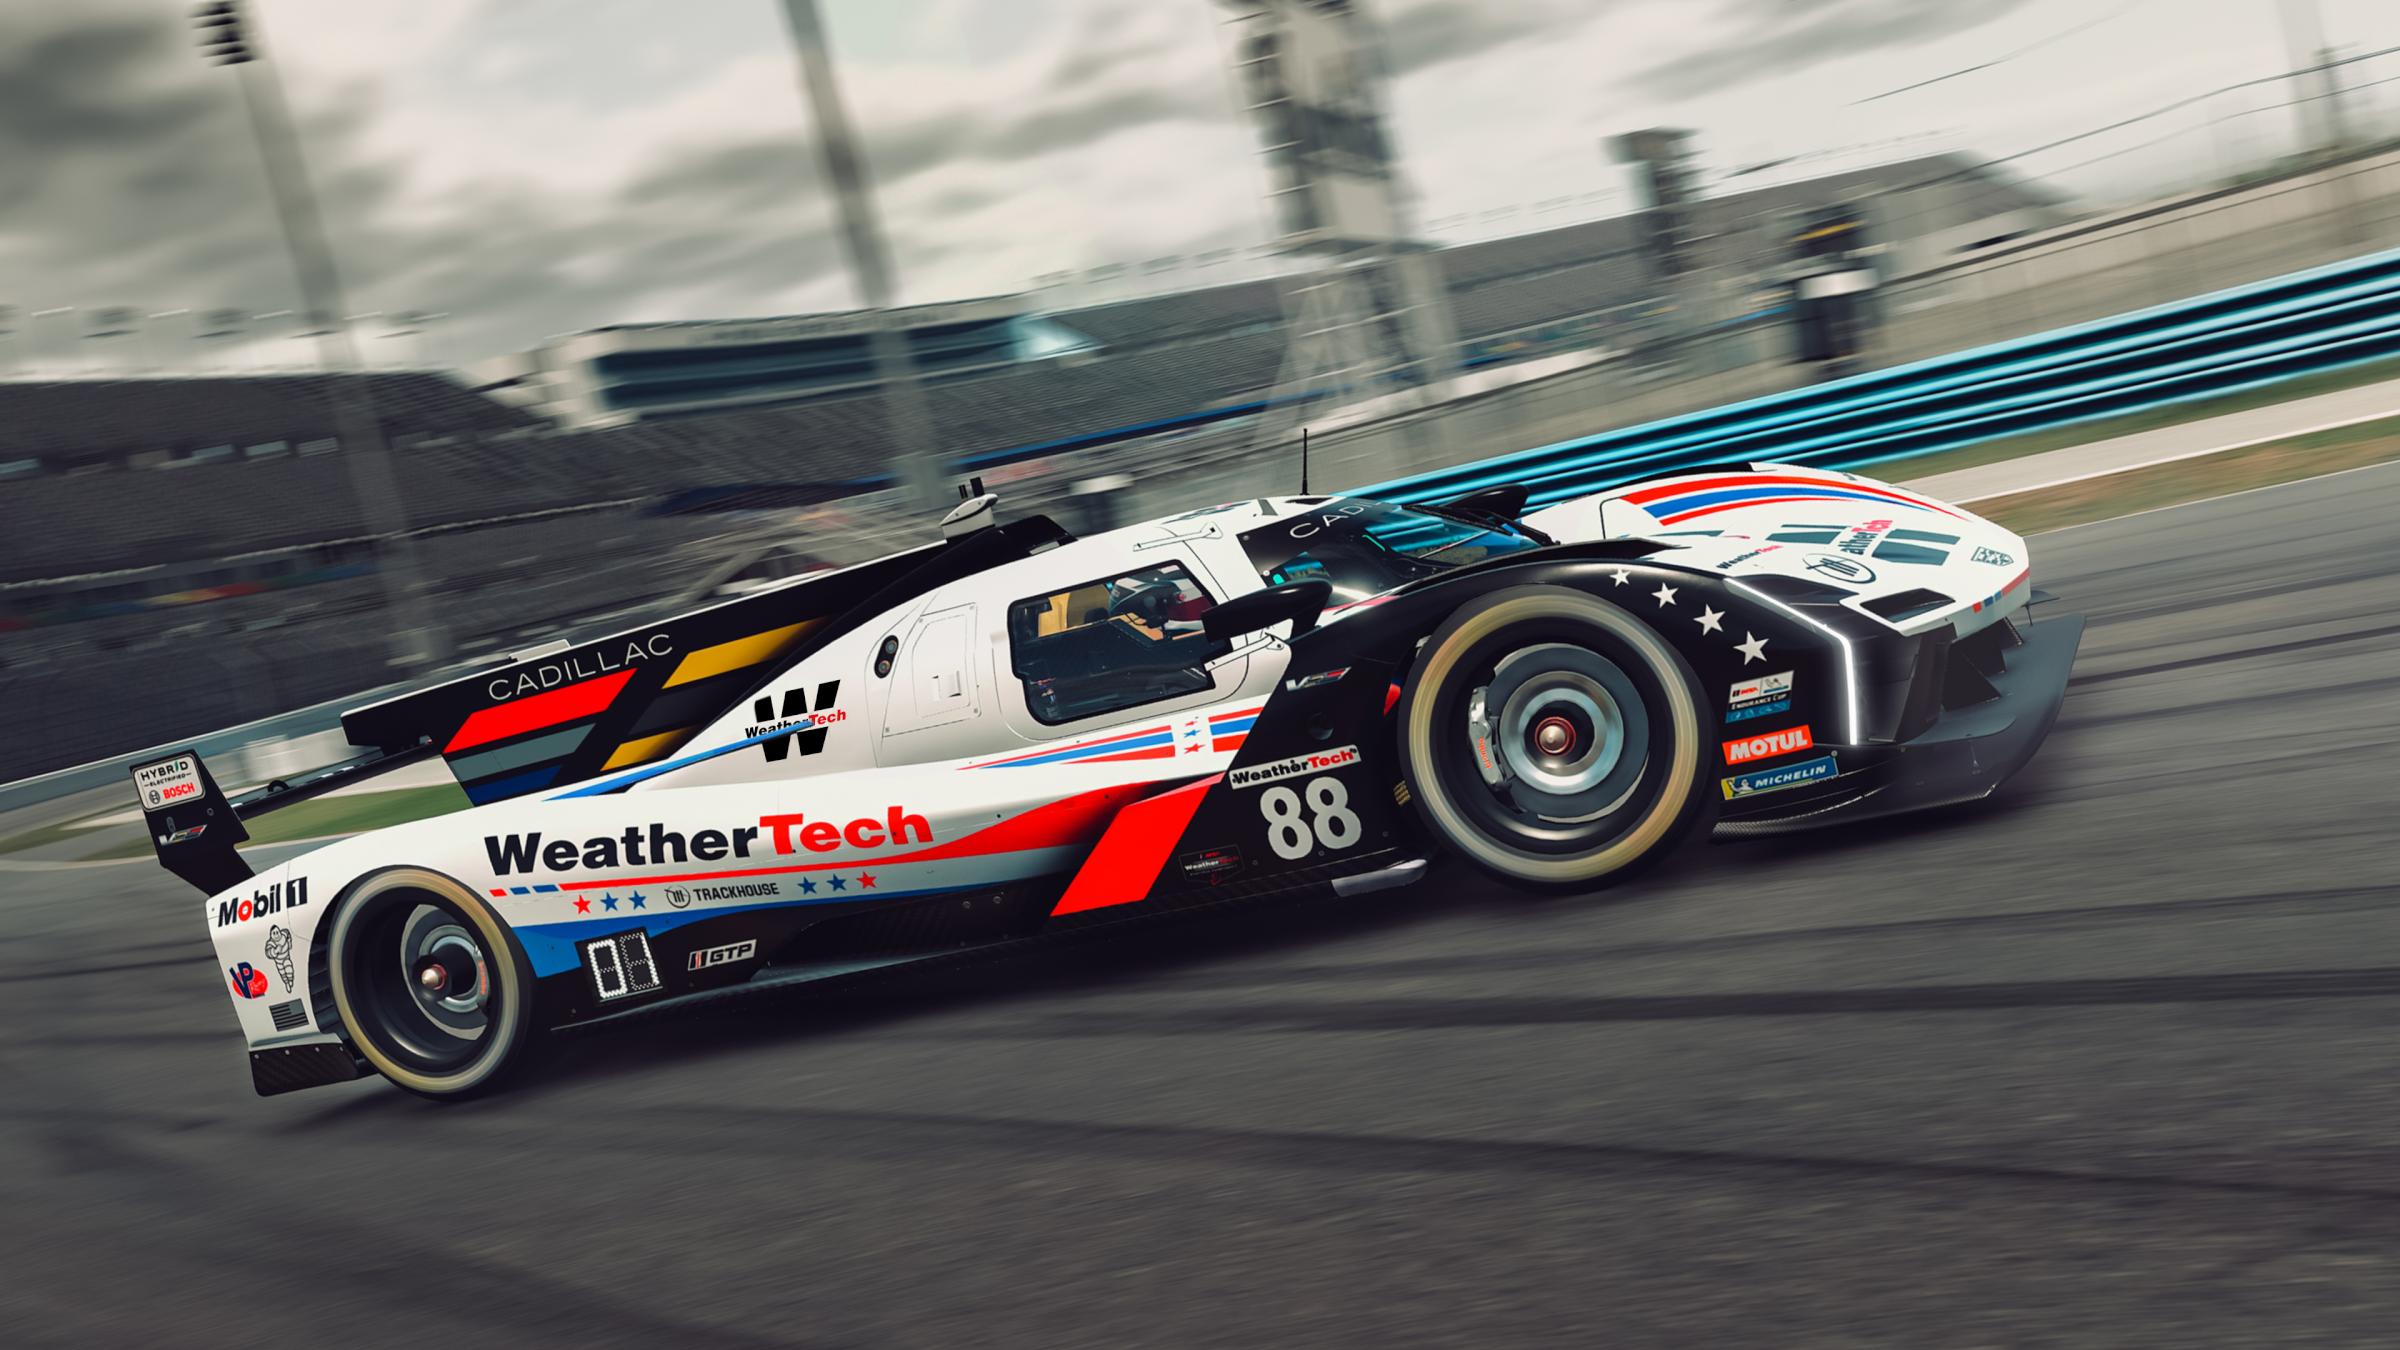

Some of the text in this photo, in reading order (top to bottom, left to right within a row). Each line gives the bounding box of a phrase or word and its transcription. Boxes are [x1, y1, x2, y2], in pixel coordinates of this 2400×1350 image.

[488, 633, 674, 701] CADILLAC
[1730, 730, 1807, 761] MOTUL
[141, 761, 189, 781] HYBRID
[1232, 751, 1354, 784] WeatherTech
[1755, 764, 1827, 788] MICHELIN
[163, 782, 195, 799] BOSCH
[1260, 776, 1362, 860] 88
[484, 806, 934, 876] WeatherTech
[218, 883, 281, 927] Mobil
[693, 882, 780, 901] TRACKHOUSE
[709, 943, 753, 964] GTP
[229, 962, 254, 999] VP
